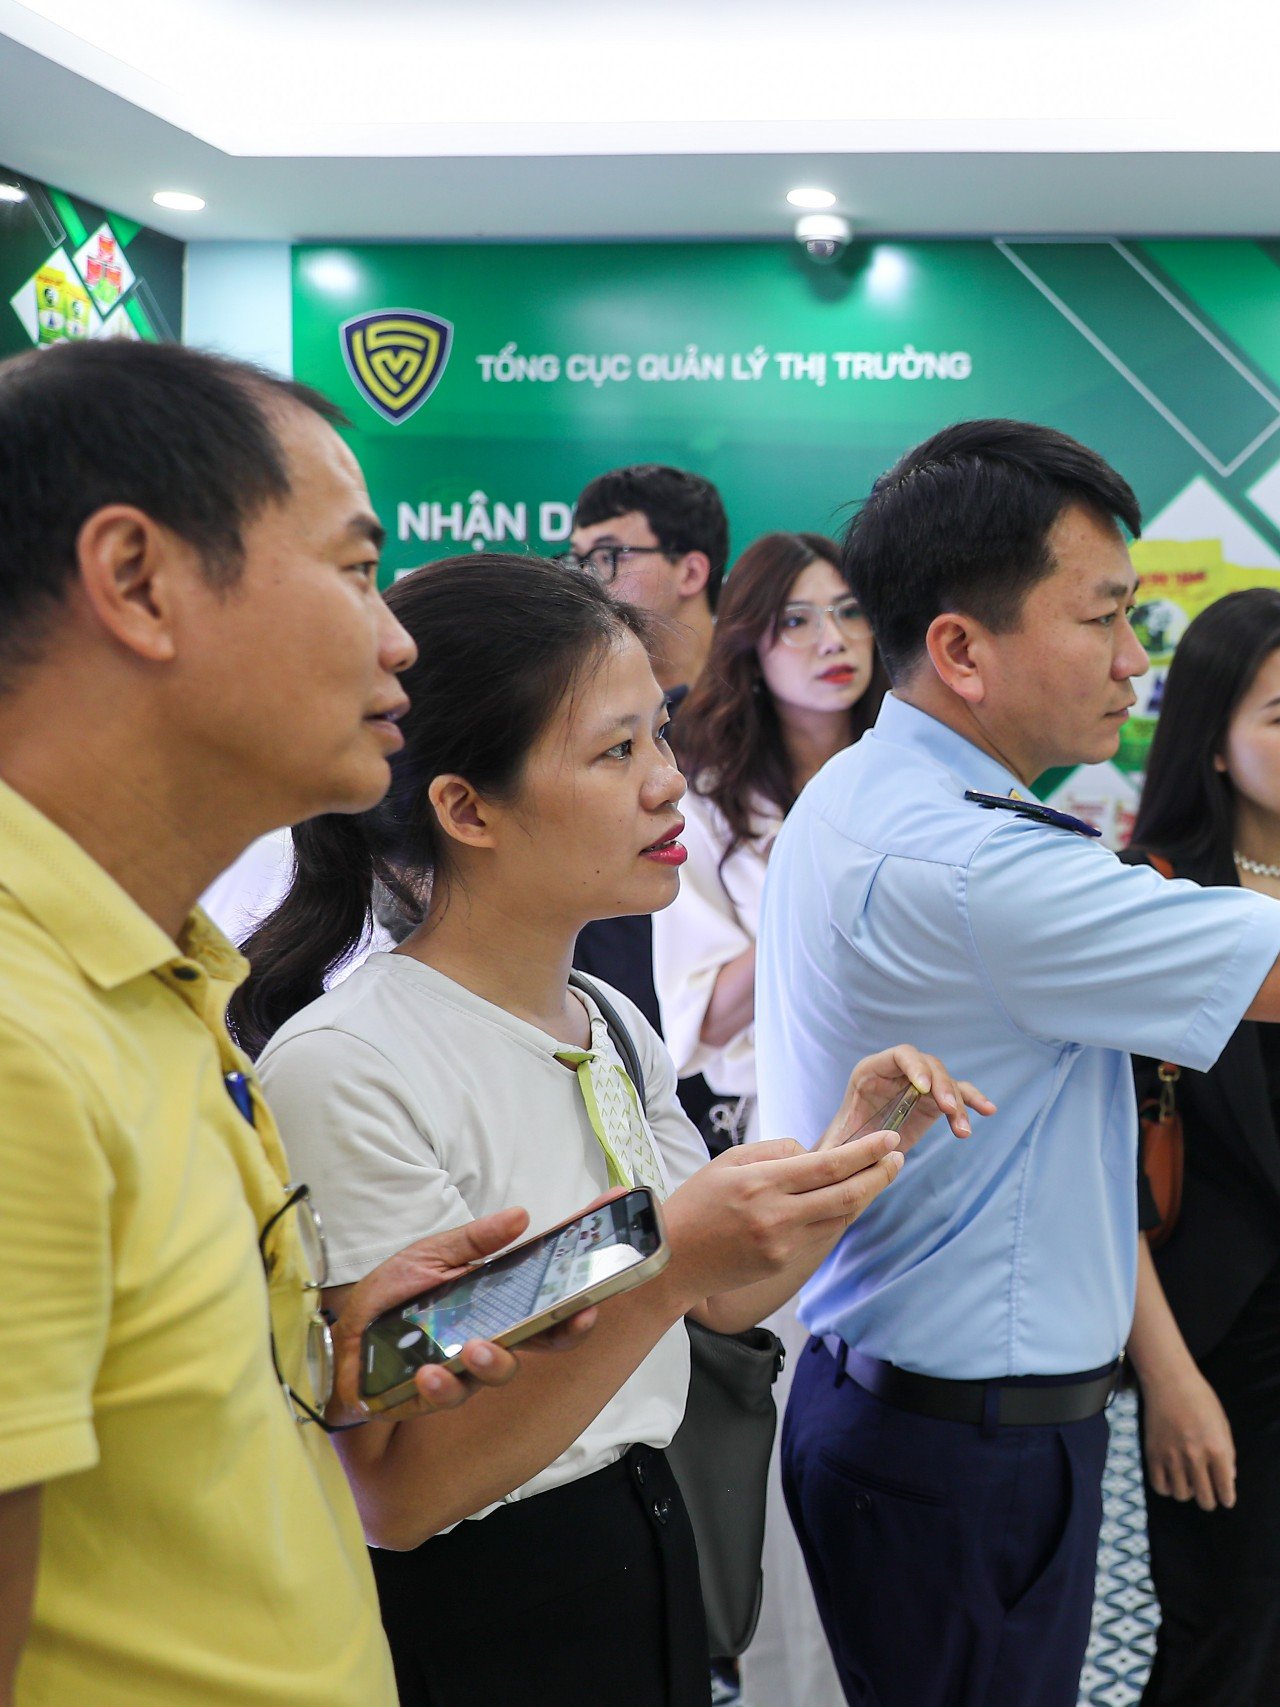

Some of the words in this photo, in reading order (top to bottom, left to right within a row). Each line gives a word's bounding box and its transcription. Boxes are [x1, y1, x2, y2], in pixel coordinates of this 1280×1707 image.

[475, 341, 561, 383] TỔNG
[566, 353, 631, 389] CỤC
[637, 343, 725, 383] QUẢN
[730, 344, 768, 381] LÝ
[773, 352, 827, 388] THỊ
[832, 343, 973, 381] TRƯỜNG
[396, 490, 527, 552] NHẬN
